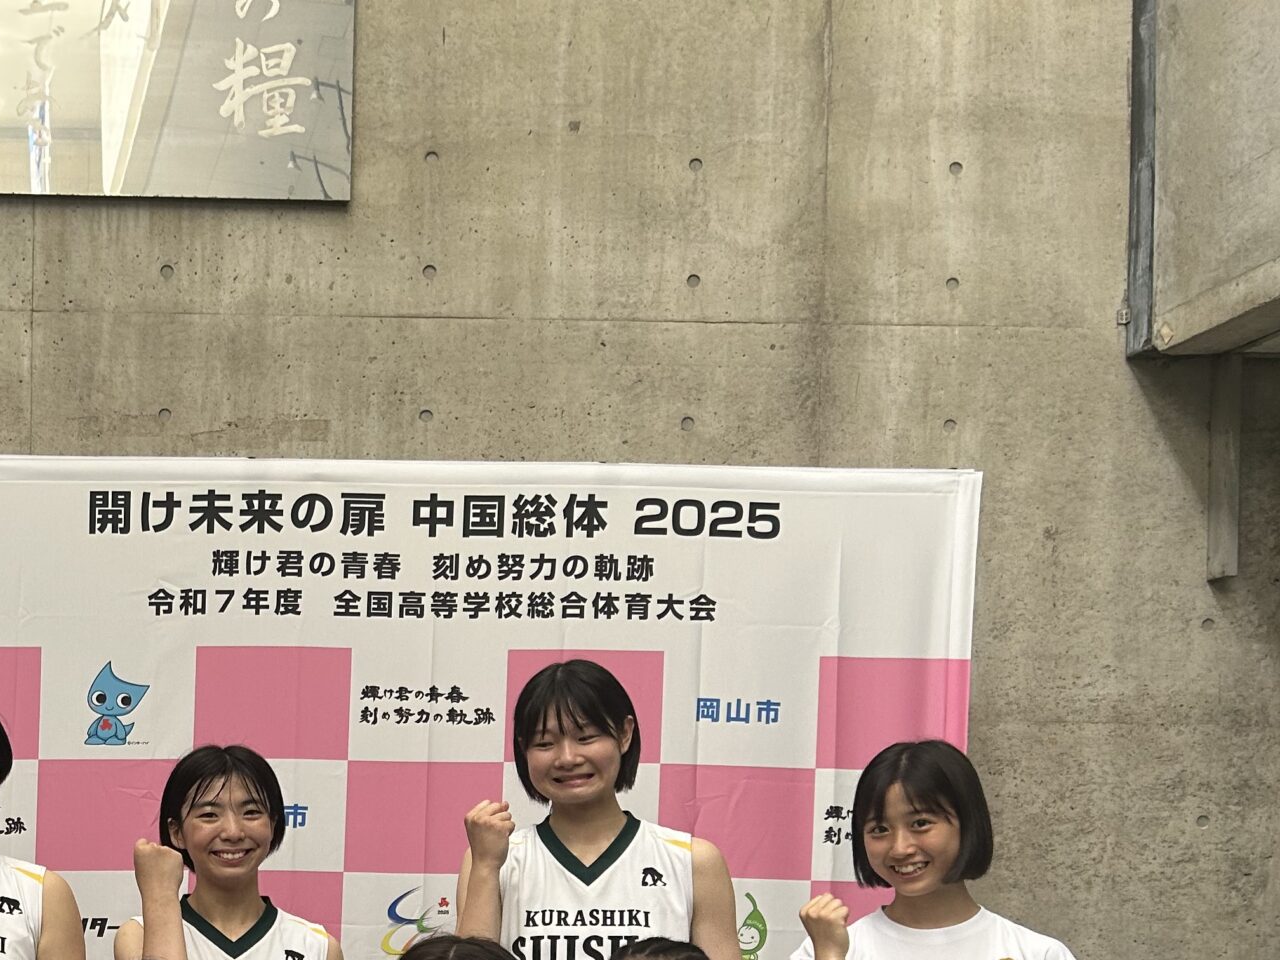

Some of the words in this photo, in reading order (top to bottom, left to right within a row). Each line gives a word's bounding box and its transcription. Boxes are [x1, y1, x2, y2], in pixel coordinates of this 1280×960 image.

[88, 489, 386, 537] 開け未来の扉
[412, 492, 608, 538] 中国総体
[633, 497, 781, 540] 2025
[211, 549, 401, 580] 輝け君の青春
[432, 552, 655, 582] 刻め努力の軌跡
[333, 590, 717, 622] 全国高等学校総合体育大会
[360, 684, 470, 704] 輝け君の青春
[359, 705, 496, 726] 刻め努力の軌跡
[695, 697, 781, 725] 岡山市
[524, 908, 651, 928] KURASHIKI
